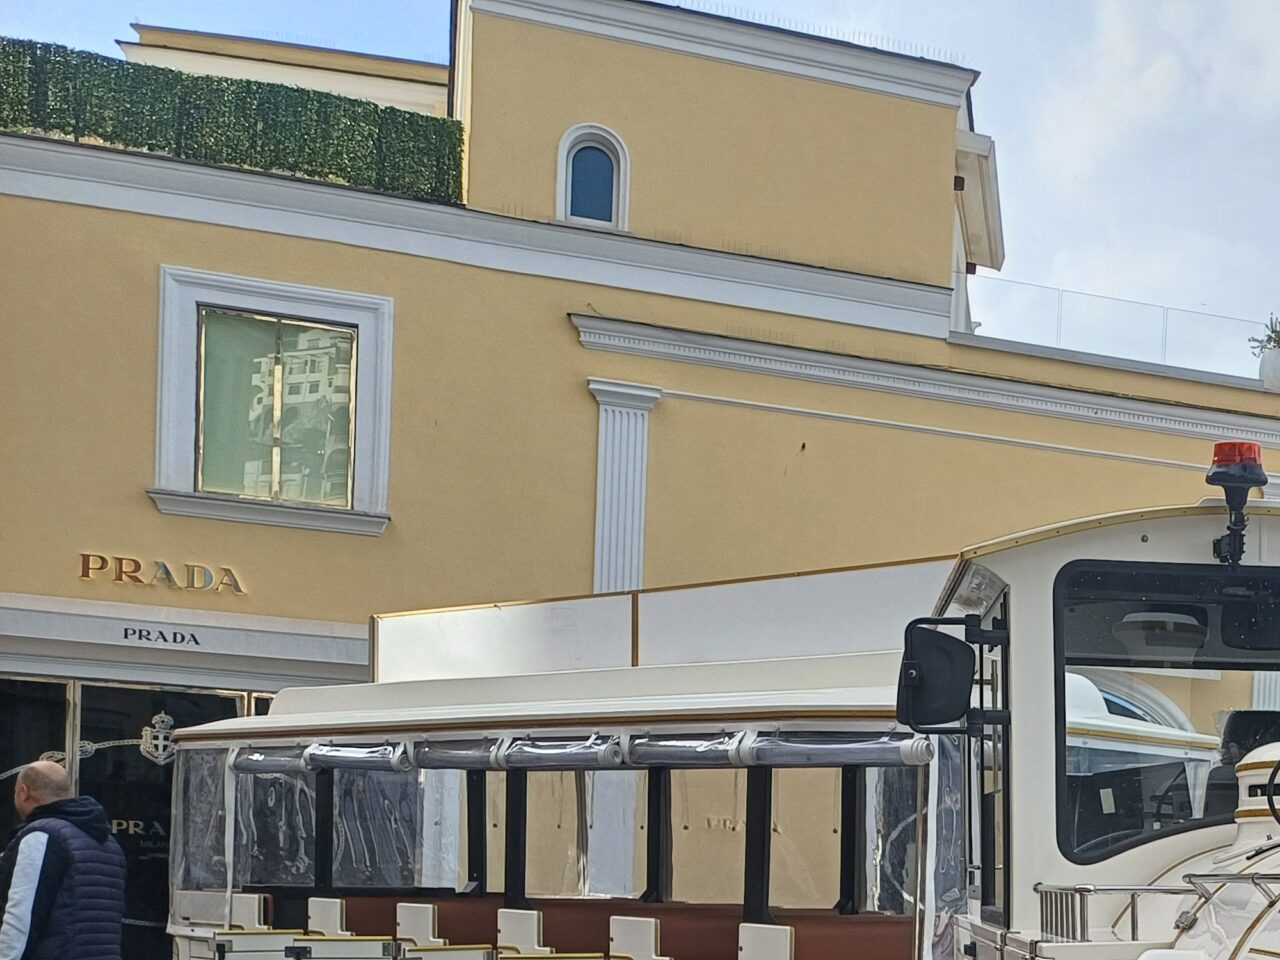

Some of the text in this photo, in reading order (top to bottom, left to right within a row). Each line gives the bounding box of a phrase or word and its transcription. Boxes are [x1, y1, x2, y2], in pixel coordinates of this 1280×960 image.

[79, 553, 247, 595] PRADA
[123, 627, 201, 646] PRADA
[111, 819, 167, 836] PRA
